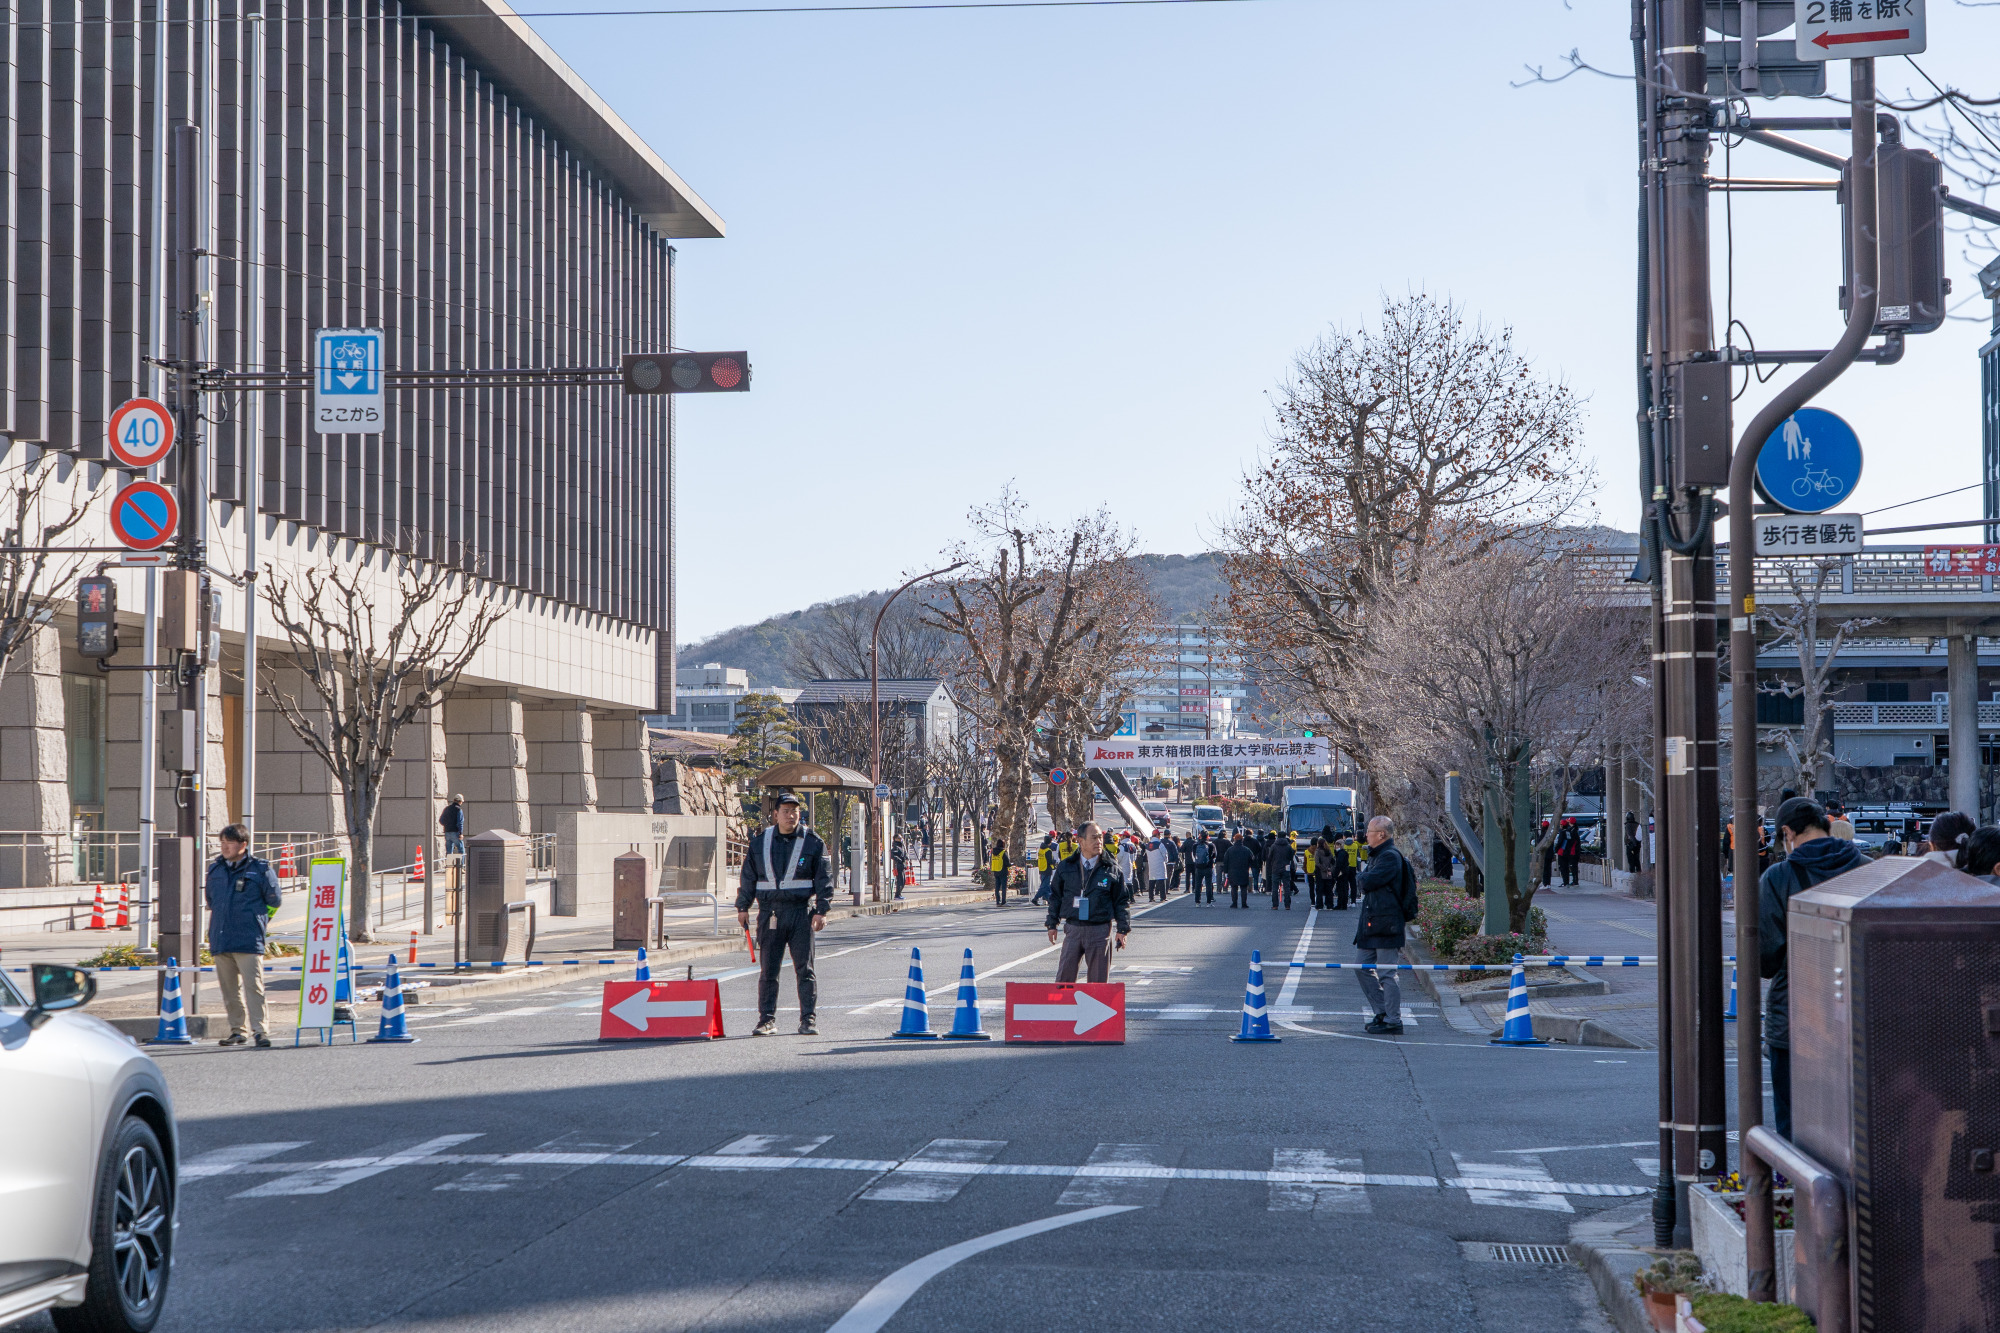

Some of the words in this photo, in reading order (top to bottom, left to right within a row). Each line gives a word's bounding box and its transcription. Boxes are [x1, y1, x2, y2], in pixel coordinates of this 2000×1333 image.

[1806, 0, 1914, 24] 2輪を除く
[320, 407, 379, 422] ここから
[124, 417, 159, 447] 40
[1763, 523, 1856, 546] 歩行者優先
[1977, 547, 2000, 559] メダ
[1985, 560, 2000, 573] お
[1138, 742, 1317, 758] 東京箱根間往復大学駅伝競走
[308, 885, 336, 1006] 通行止め
